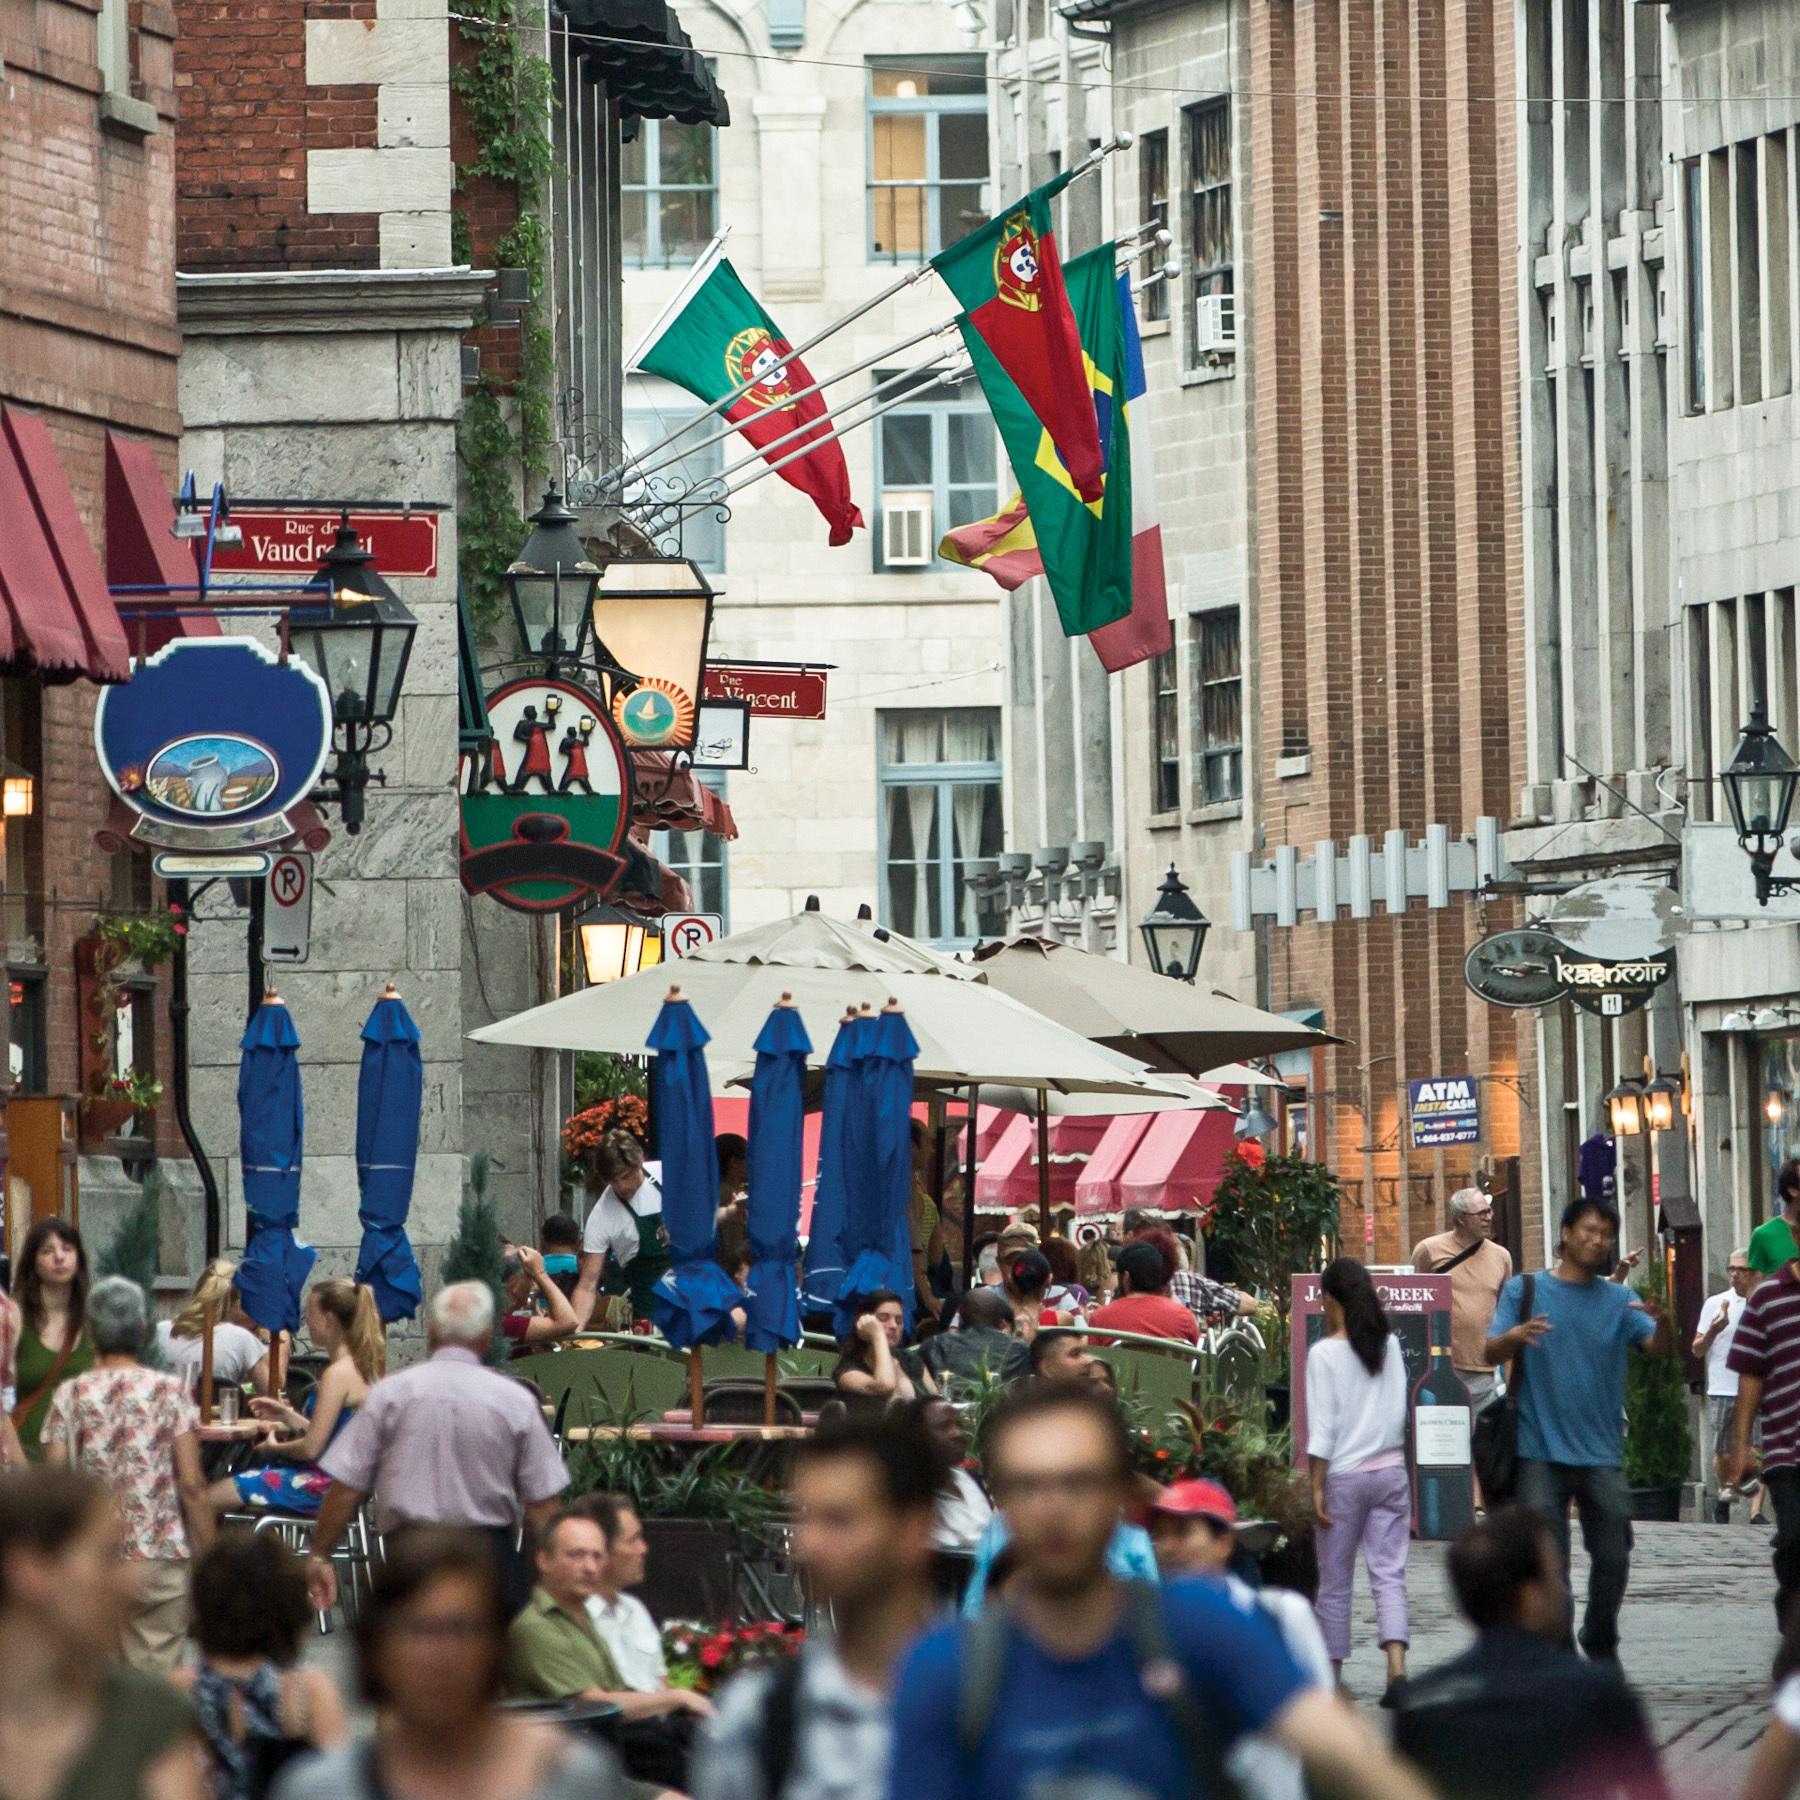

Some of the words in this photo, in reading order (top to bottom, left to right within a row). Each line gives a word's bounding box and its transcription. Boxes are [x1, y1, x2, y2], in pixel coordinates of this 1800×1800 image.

[285, 520, 314, 535] Rue
[321, 520, 340, 535] de
[251, 535, 373, 562] Vaudril
[1417, 1080, 1470, 1103] ATM
[1376, 1285, 1436, 1301] CREEK
